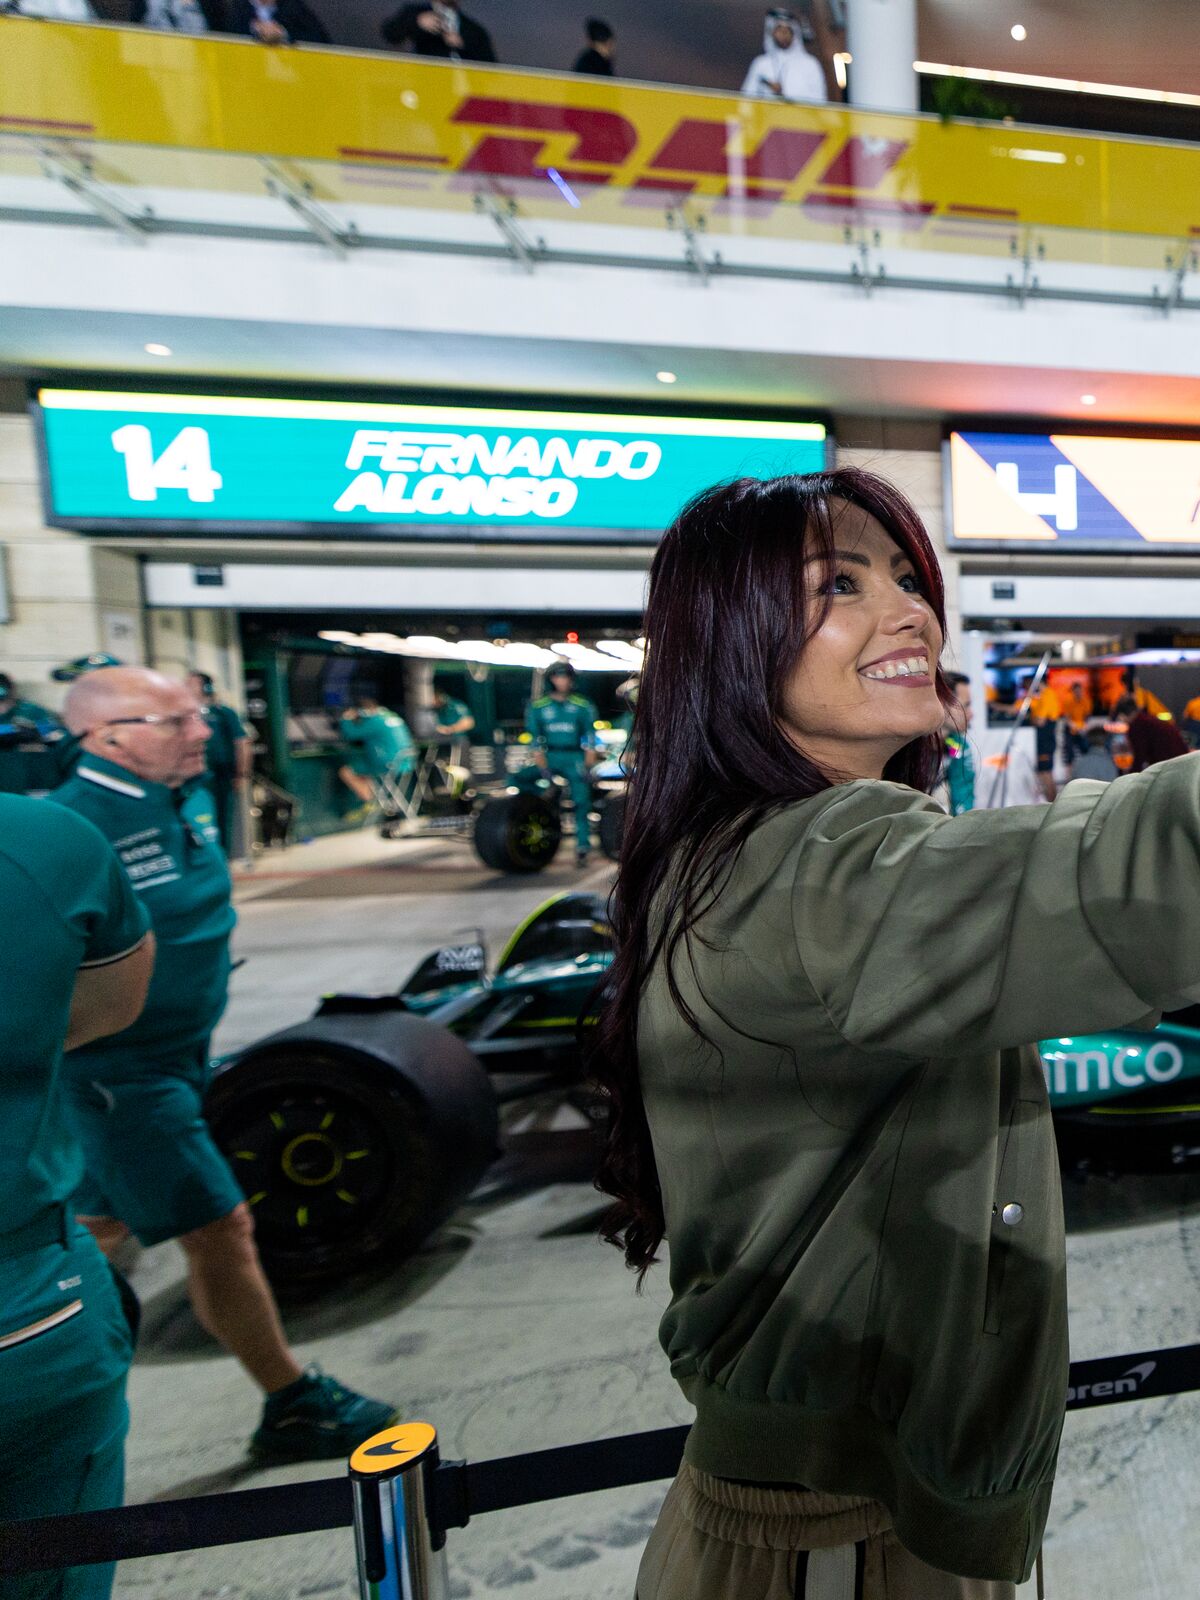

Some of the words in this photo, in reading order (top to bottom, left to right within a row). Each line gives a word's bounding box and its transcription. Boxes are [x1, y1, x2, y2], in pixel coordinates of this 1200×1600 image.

[447, 96, 935, 230] DHL
[112, 425, 222, 502] 14
[345, 430, 661, 480] FERNANDO
[334, 472, 578, 517] ALONSO
[1047, 1041, 1183, 1093] mco
[1066, 1377, 1137, 1402] aren
